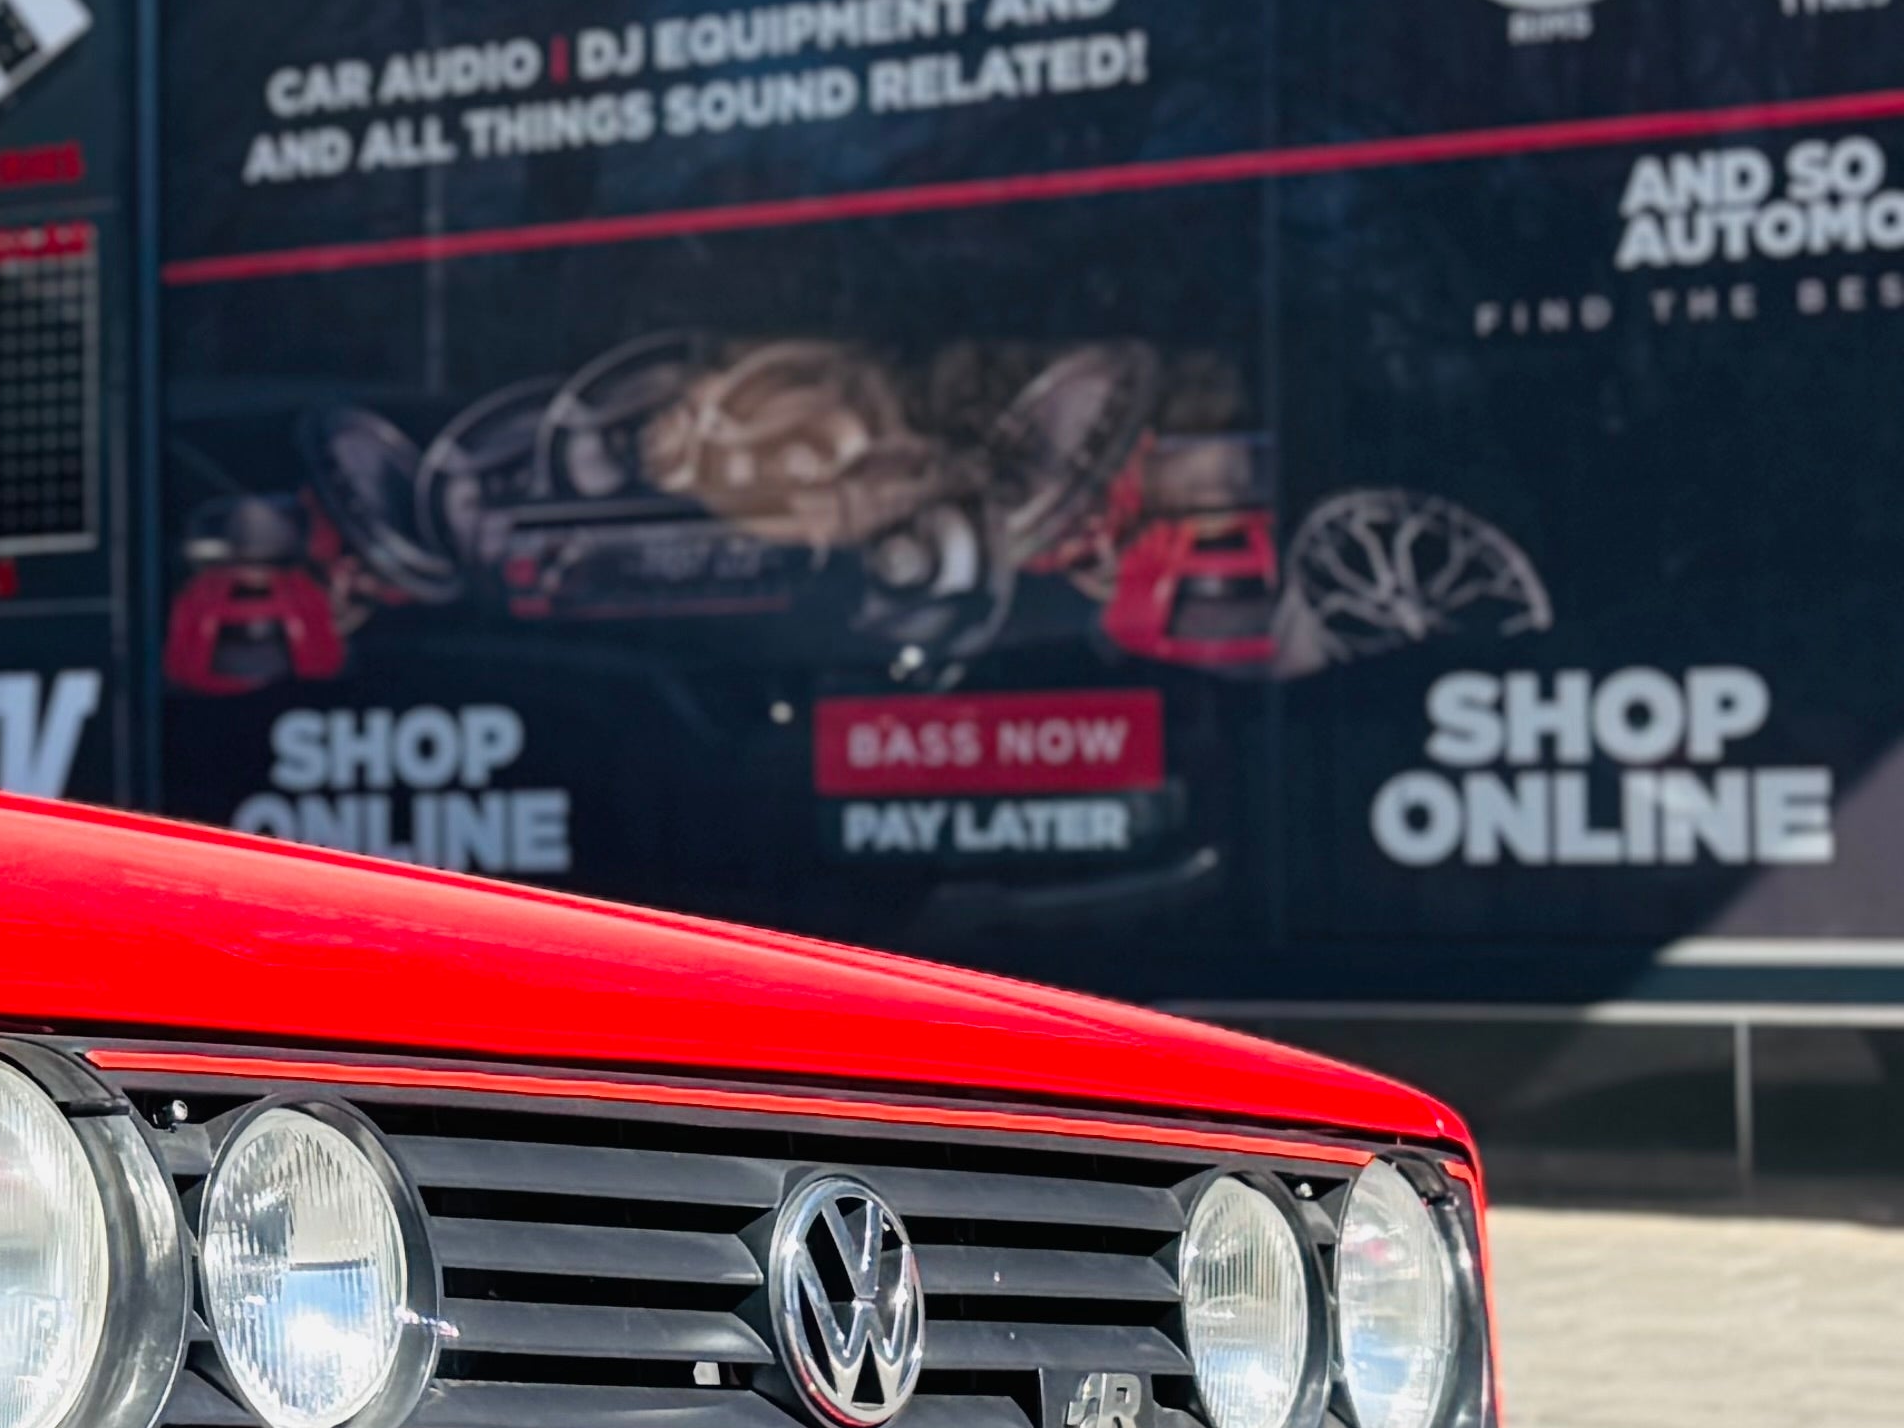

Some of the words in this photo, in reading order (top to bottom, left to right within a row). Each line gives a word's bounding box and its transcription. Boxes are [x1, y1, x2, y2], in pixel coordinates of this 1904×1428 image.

[244, 129, 353, 186] AND
[356, 117, 458, 174] ALL
[461, 91, 655, 161] THINGS
[662, 69, 859, 139] SOUND
[867, 30, 1147, 113] RELATED!
[266, 62, 372, 119] CAR
[378, 38, 541, 106] AUDIO
[577, 24, 644, 80] DJ
[1618, 145, 1773, 218] AND
[1784, 135, 1886, 203] SO
[1613, 189, 1904, 271] AUTOMO
[269, 704, 525, 793] SHOP
[847, 721, 983, 769] BASS
[995, 716, 1130, 765] NOW
[1424, 665, 1771, 768] SHOP
[842, 800, 947, 854] PAY
[953, 797, 1132, 854] LATER
[1370, 766, 1836, 867] ONLINE
